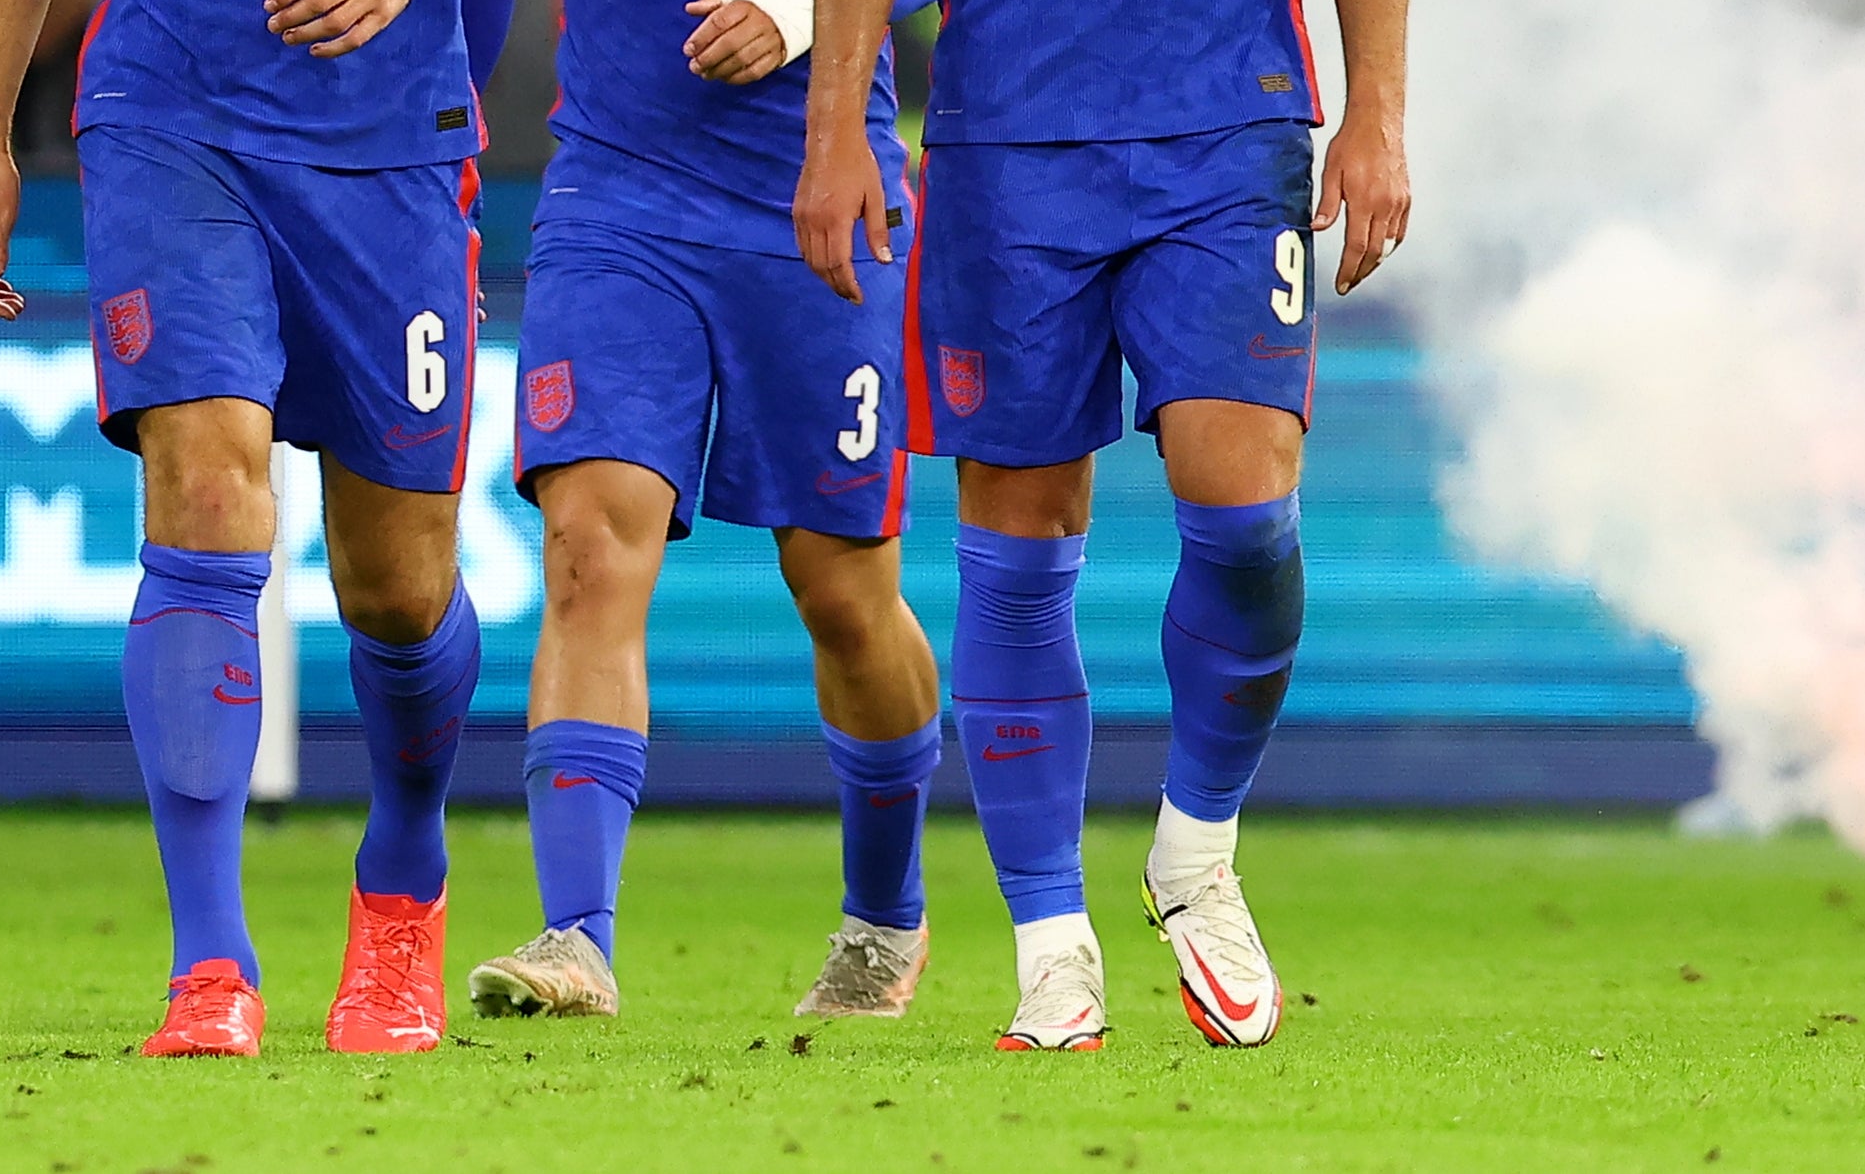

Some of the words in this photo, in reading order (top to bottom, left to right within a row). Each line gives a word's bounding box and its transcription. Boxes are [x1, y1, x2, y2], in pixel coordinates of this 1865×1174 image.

[1269, 228, 1306, 326] 9
[404, 309, 448, 414] 6
[836, 363, 881, 463] 3
